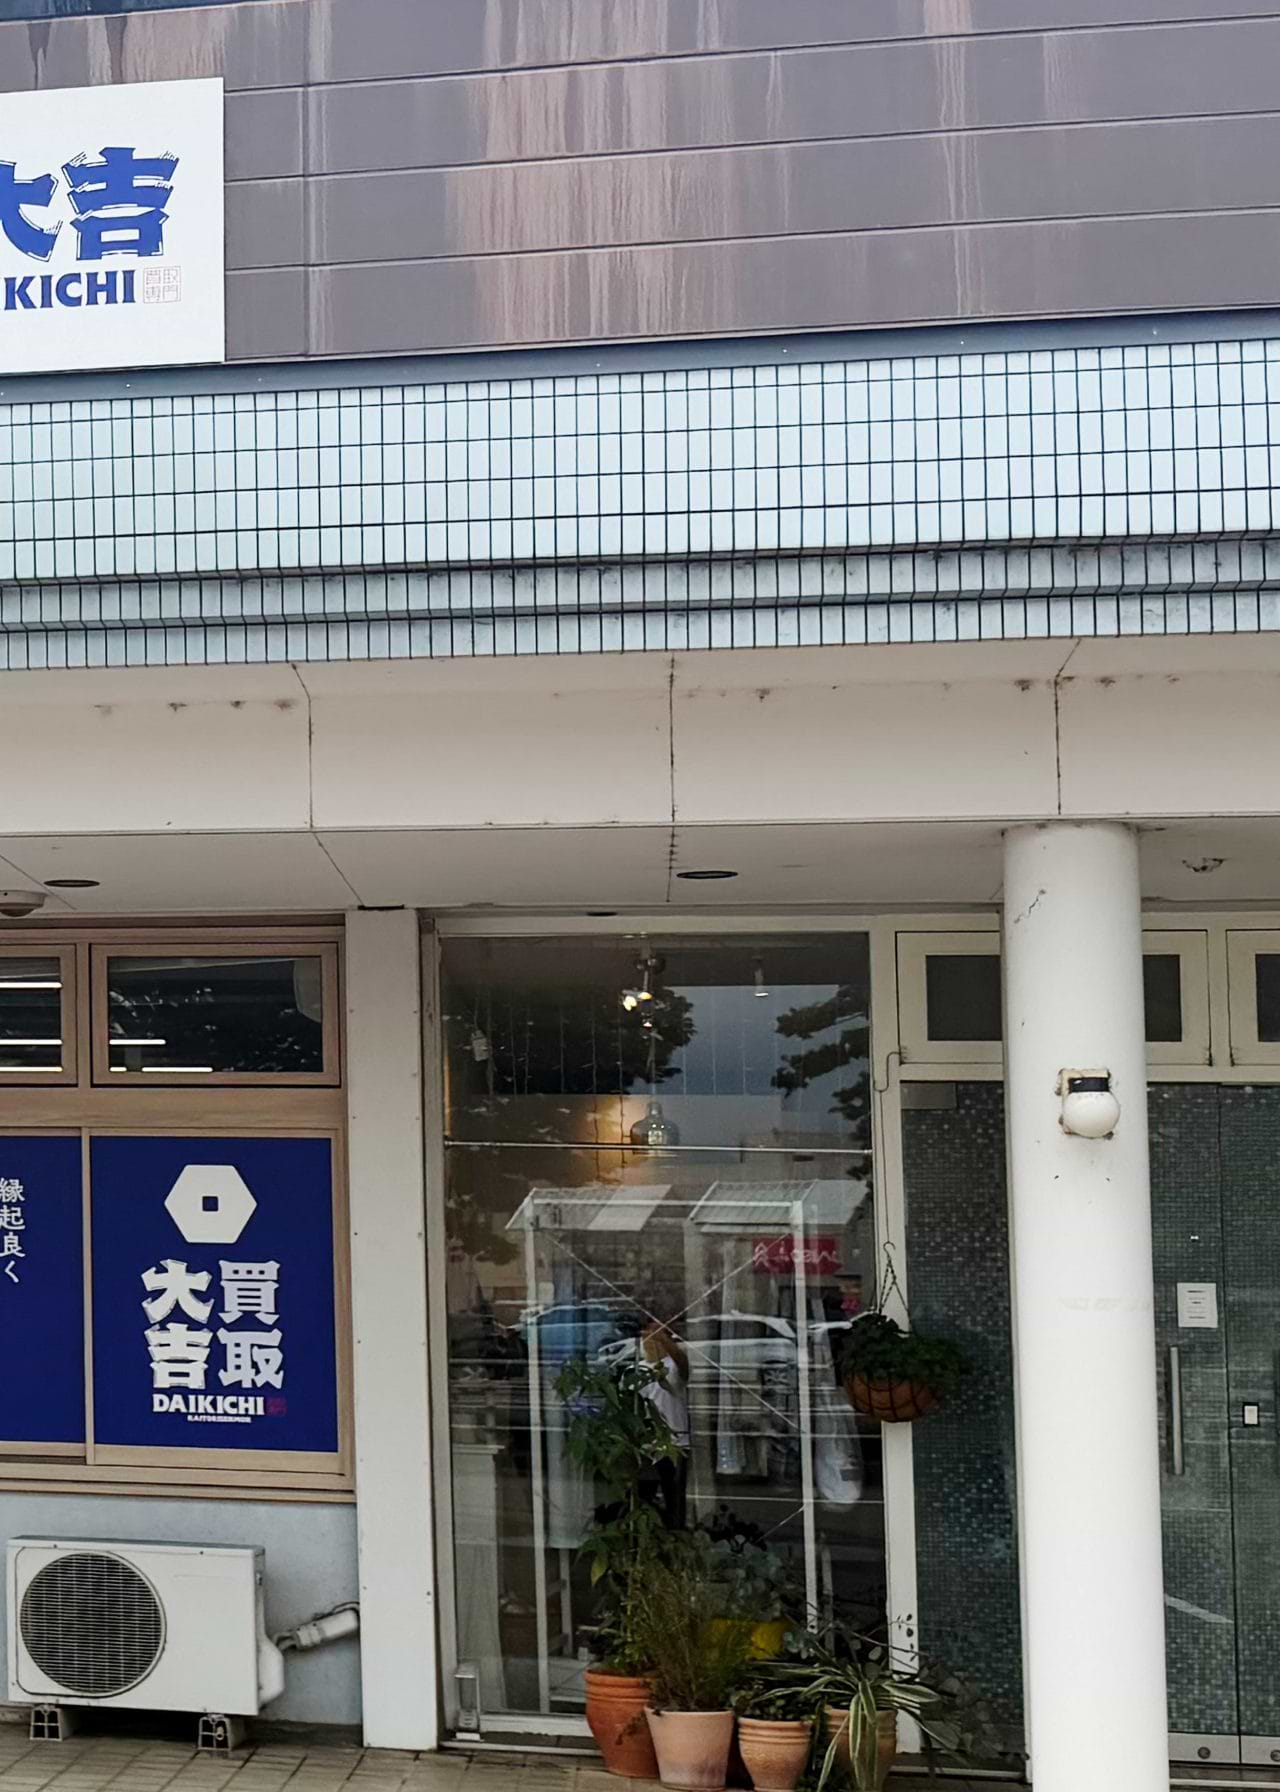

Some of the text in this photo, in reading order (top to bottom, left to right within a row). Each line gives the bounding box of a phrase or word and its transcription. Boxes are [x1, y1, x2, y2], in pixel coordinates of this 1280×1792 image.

[141, 1259, 215, 1390] 大吉
[217, 1259, 284, 1390] 買取
[152, 1393, 265, 1416] DAIKICHI
